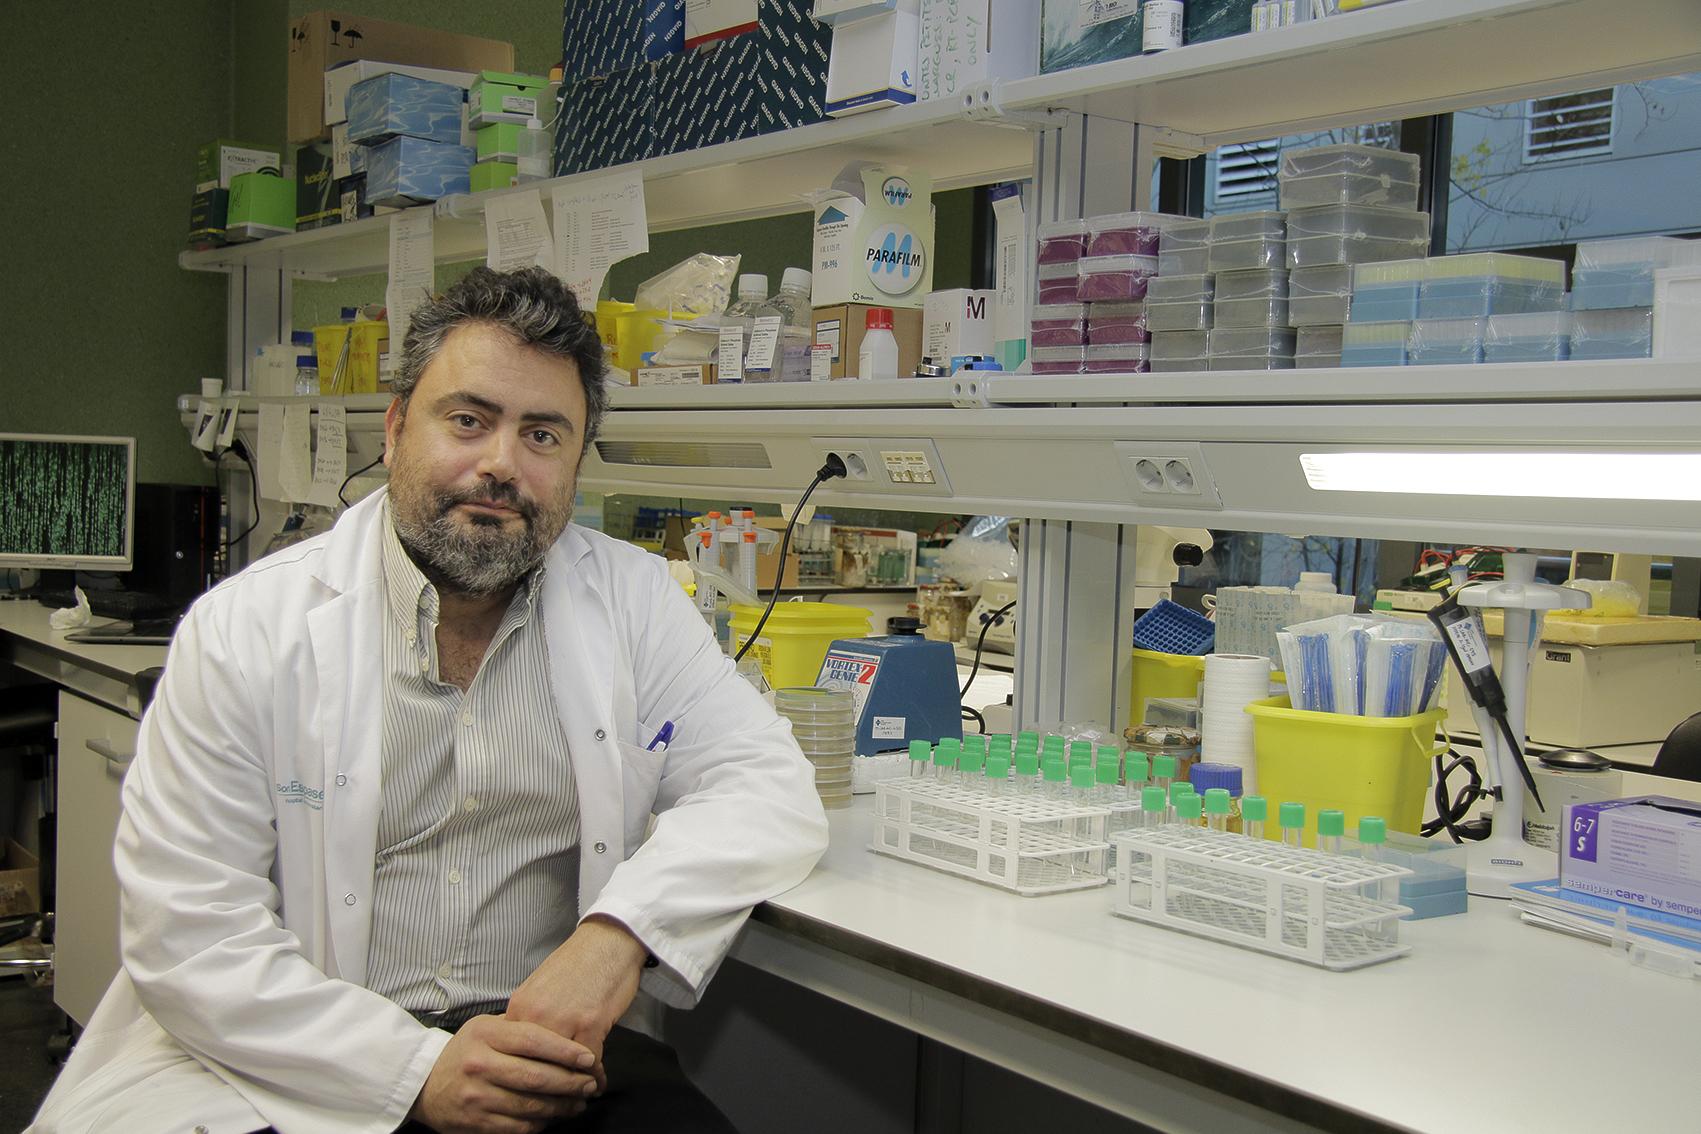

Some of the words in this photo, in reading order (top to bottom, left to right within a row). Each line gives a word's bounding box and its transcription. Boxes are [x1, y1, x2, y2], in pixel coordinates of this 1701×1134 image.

[787, 1, 801, 23] QIAGEN
[776, 25, 790, 46] QIAGEN
[794, 32, 808, 54] QIAGEN
[765, 48, 778, 70] QIAGEN
[812, 40, 827, 62] QIAGEN
[782, 56, 796, 78] QIAGEN
[801, 64, 816, 86] QIAGEN
[772, 80, 785, 101] QIAGEN
[789, 87, 804, 109] QIAGEN
[761, 102, 774, 124] QIAGEN
[808, 96, 823, 118] QIAGEN
[866, 248, 921, 267] PARAFILM
[858, 664, 877, 685] 2
[1574, 816, 1595, 834] 6-7
[1576, 836, 1586, 852] S
[1651, 896, 1663, 909] by
